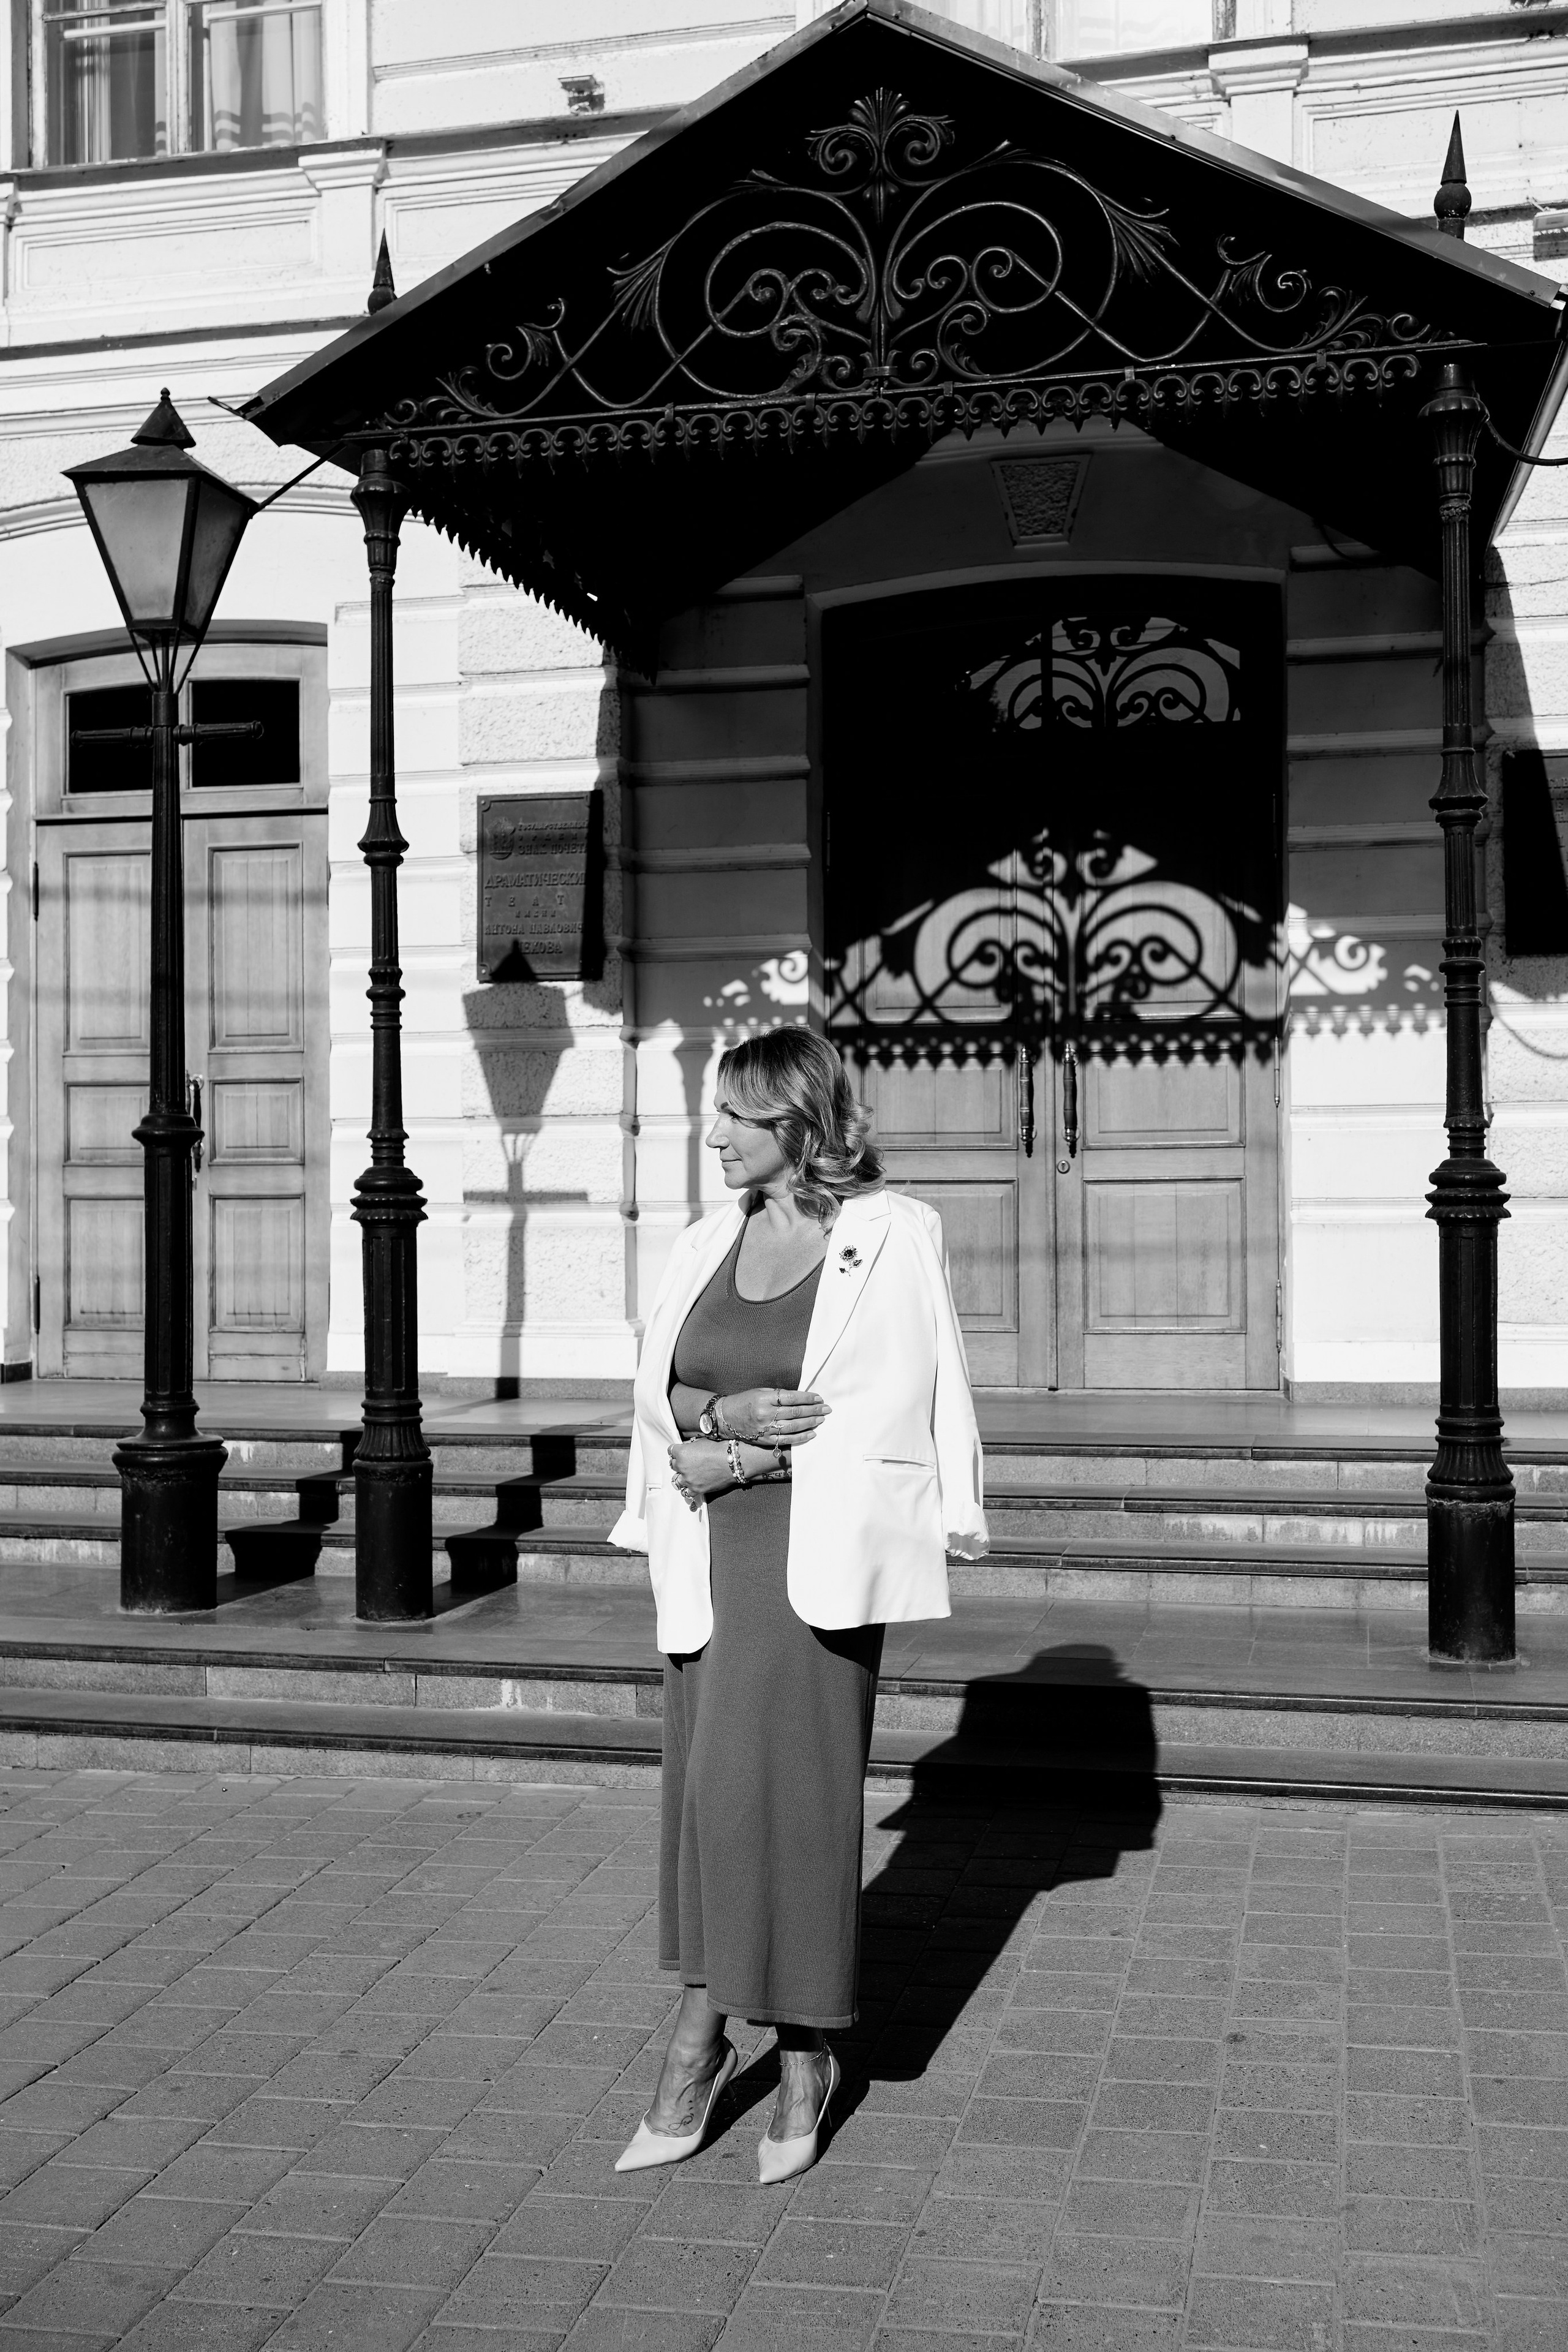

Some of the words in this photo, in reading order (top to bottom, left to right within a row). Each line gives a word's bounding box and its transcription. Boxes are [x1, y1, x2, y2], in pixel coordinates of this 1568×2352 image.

[518, 843, 548, 856] ЗНАК
[484, 872, 586, 889] ДРАМАТИЧЕСКИ
[484, 895, 565, 907] ТЕАТ
[484, 924, 525, 935] АНТОНА
[529, 922, 584, 934] ПАВЛОВИЧ
